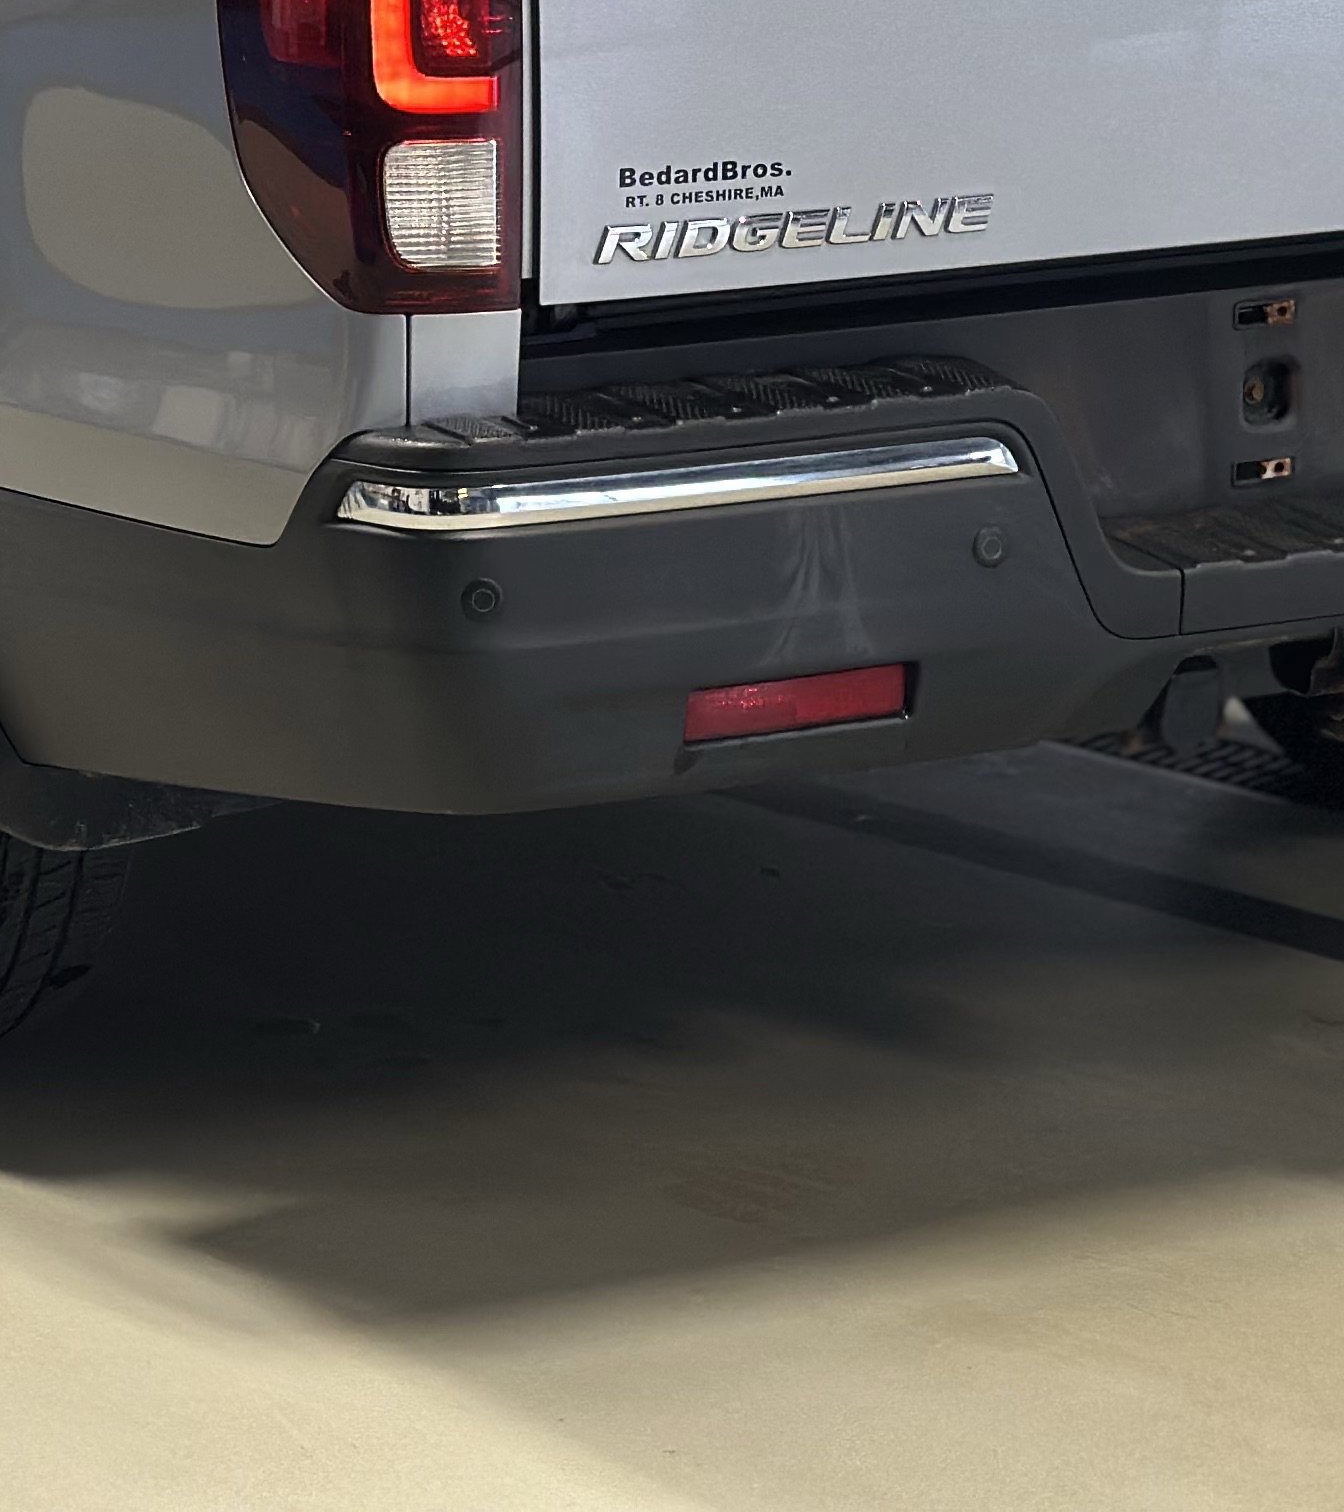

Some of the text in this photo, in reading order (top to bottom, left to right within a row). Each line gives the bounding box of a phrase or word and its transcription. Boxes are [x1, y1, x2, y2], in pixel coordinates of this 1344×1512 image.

[619, 160, 792, 188] BedardBros.
[625, 195, 650, 208] RT.
[655, 194, 664, 206] 8
[593, 193, 994, 264] RIDGELINE
